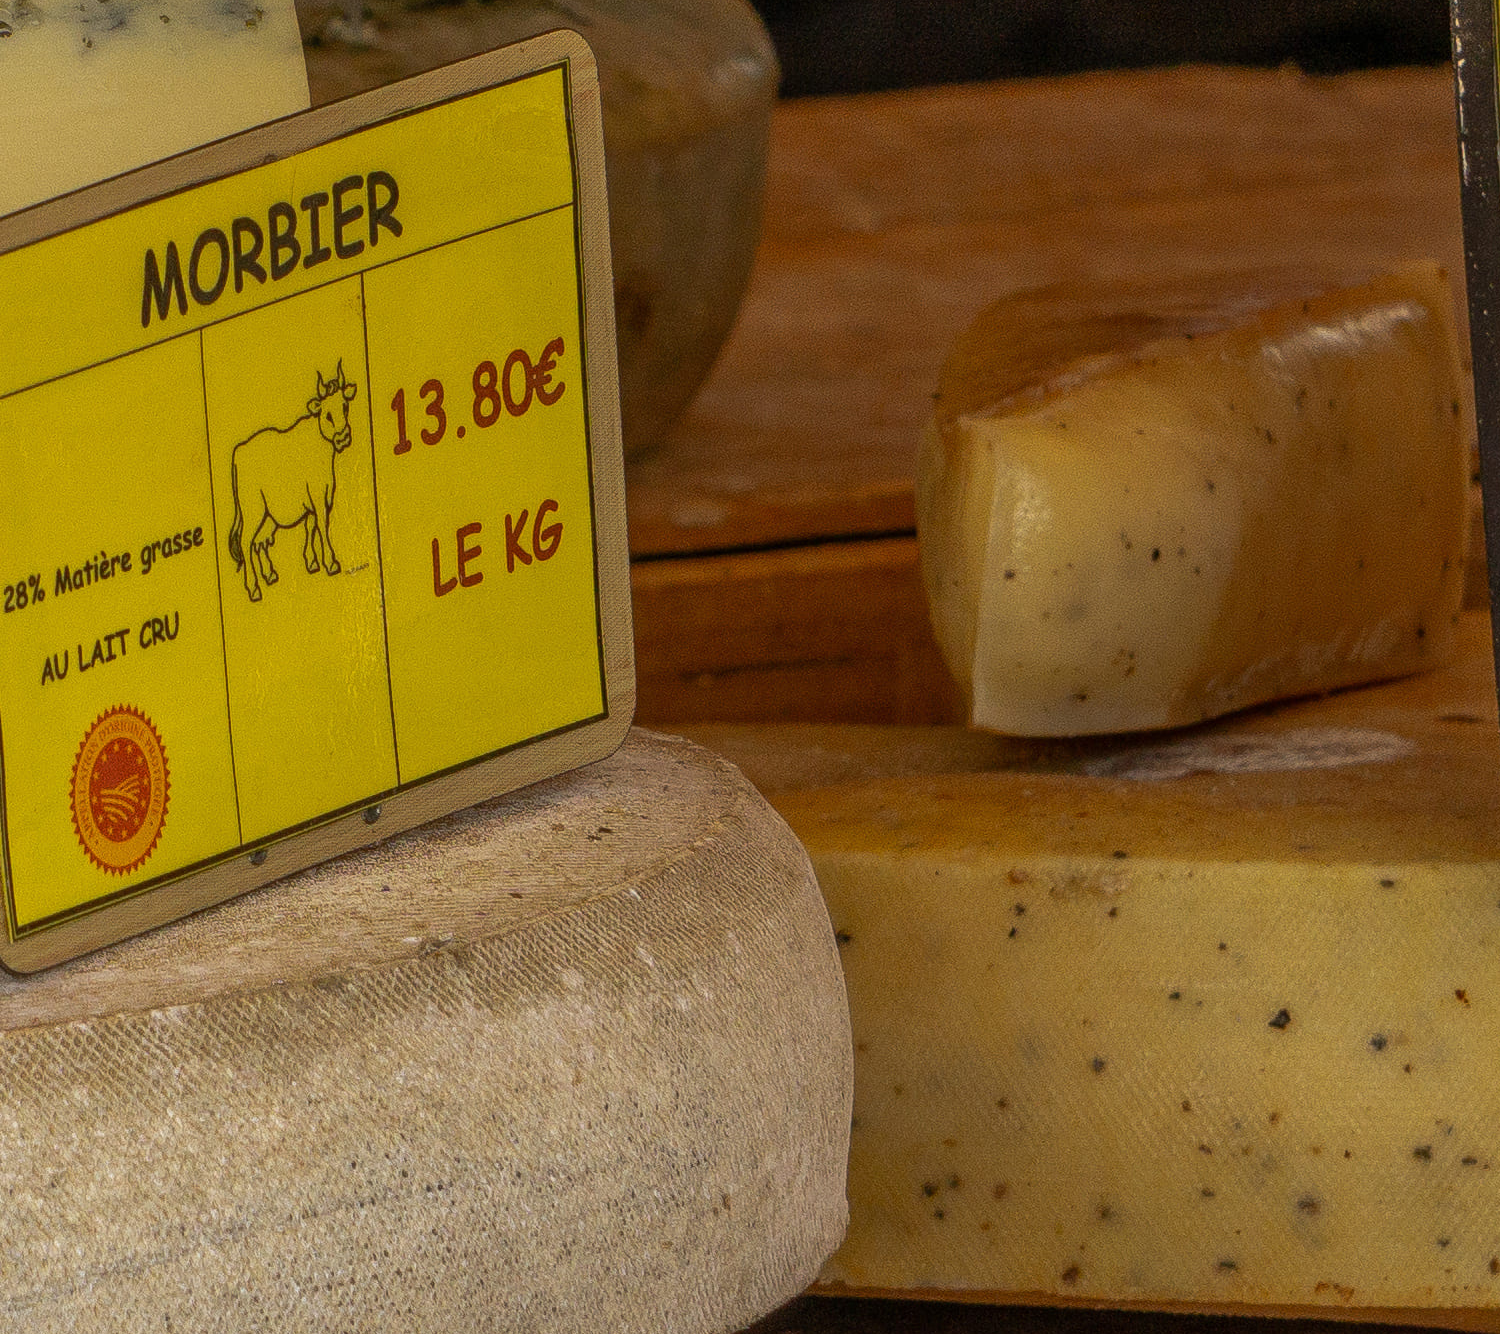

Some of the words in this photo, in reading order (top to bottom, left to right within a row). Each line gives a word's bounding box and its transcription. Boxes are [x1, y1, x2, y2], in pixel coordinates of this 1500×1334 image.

[141, 169, 404, 328] MORBIER
[390, 335, 566, 456] 13.80€
[3, 573, 47, 615] 28%
[53, 550, 133, 597] Matière
[139, 525, 205, 576] grasse
[431, 521, 484, 598] LE
[504, 498, 564, 574] KG
[39, 650, 70, 686] AU
[76, 627, 131, 674] LAIT
[138, 611, 181, 650] CRU
